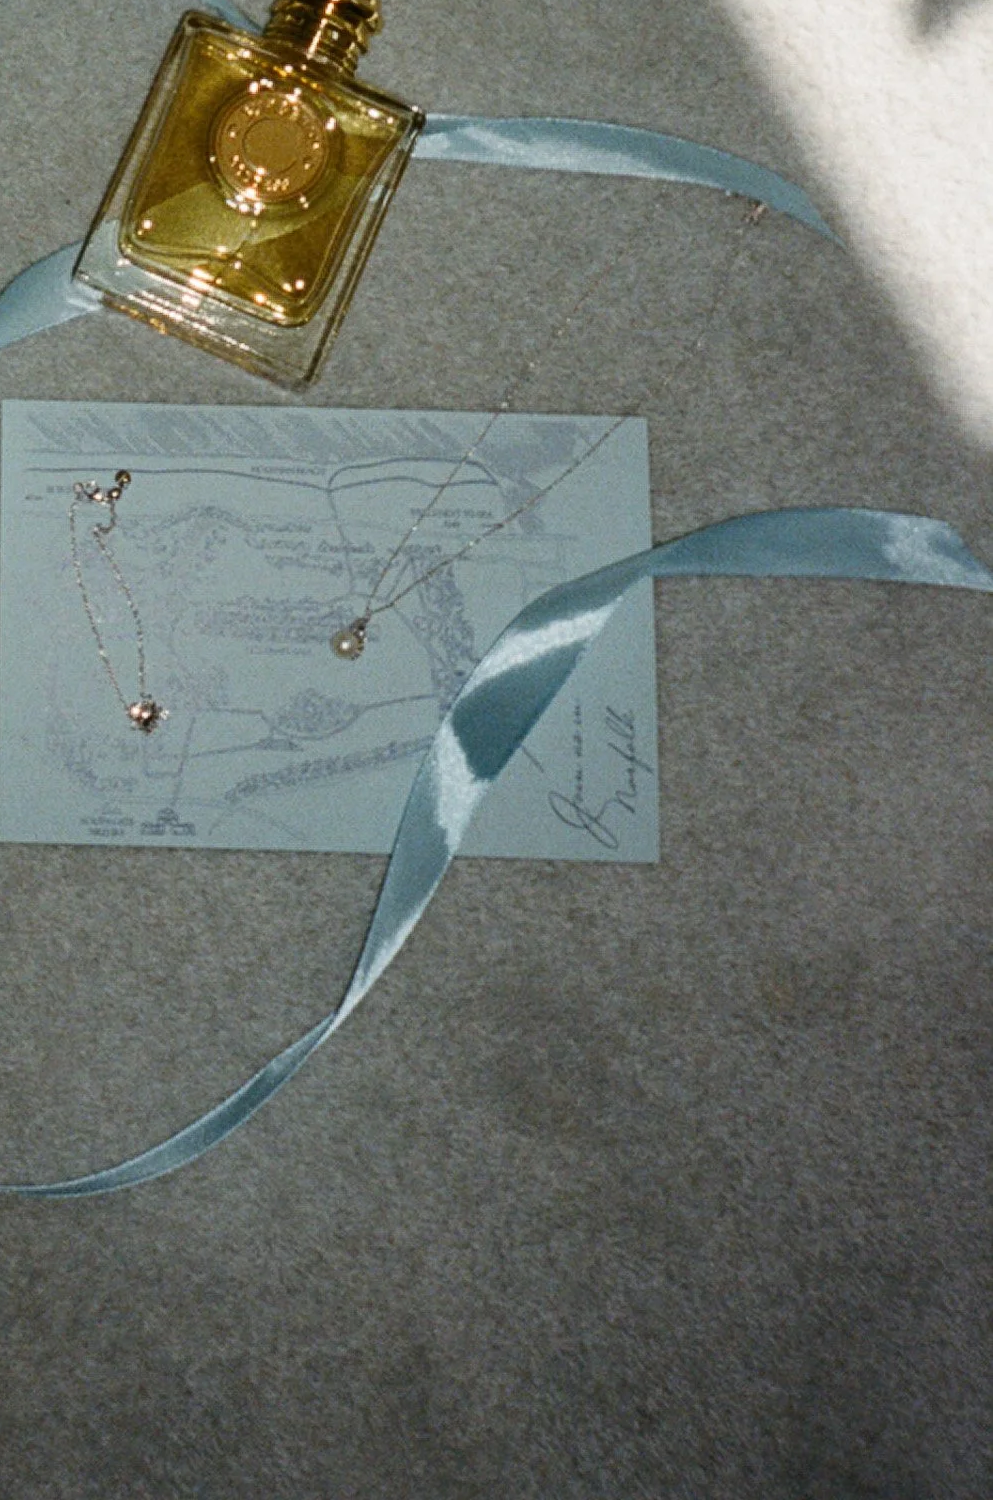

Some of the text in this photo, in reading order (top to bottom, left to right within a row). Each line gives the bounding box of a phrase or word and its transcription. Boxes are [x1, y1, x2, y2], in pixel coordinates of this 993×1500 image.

[547, 704, 618, 849] Join us in
[606, 704, 656, 814] Norfolk
